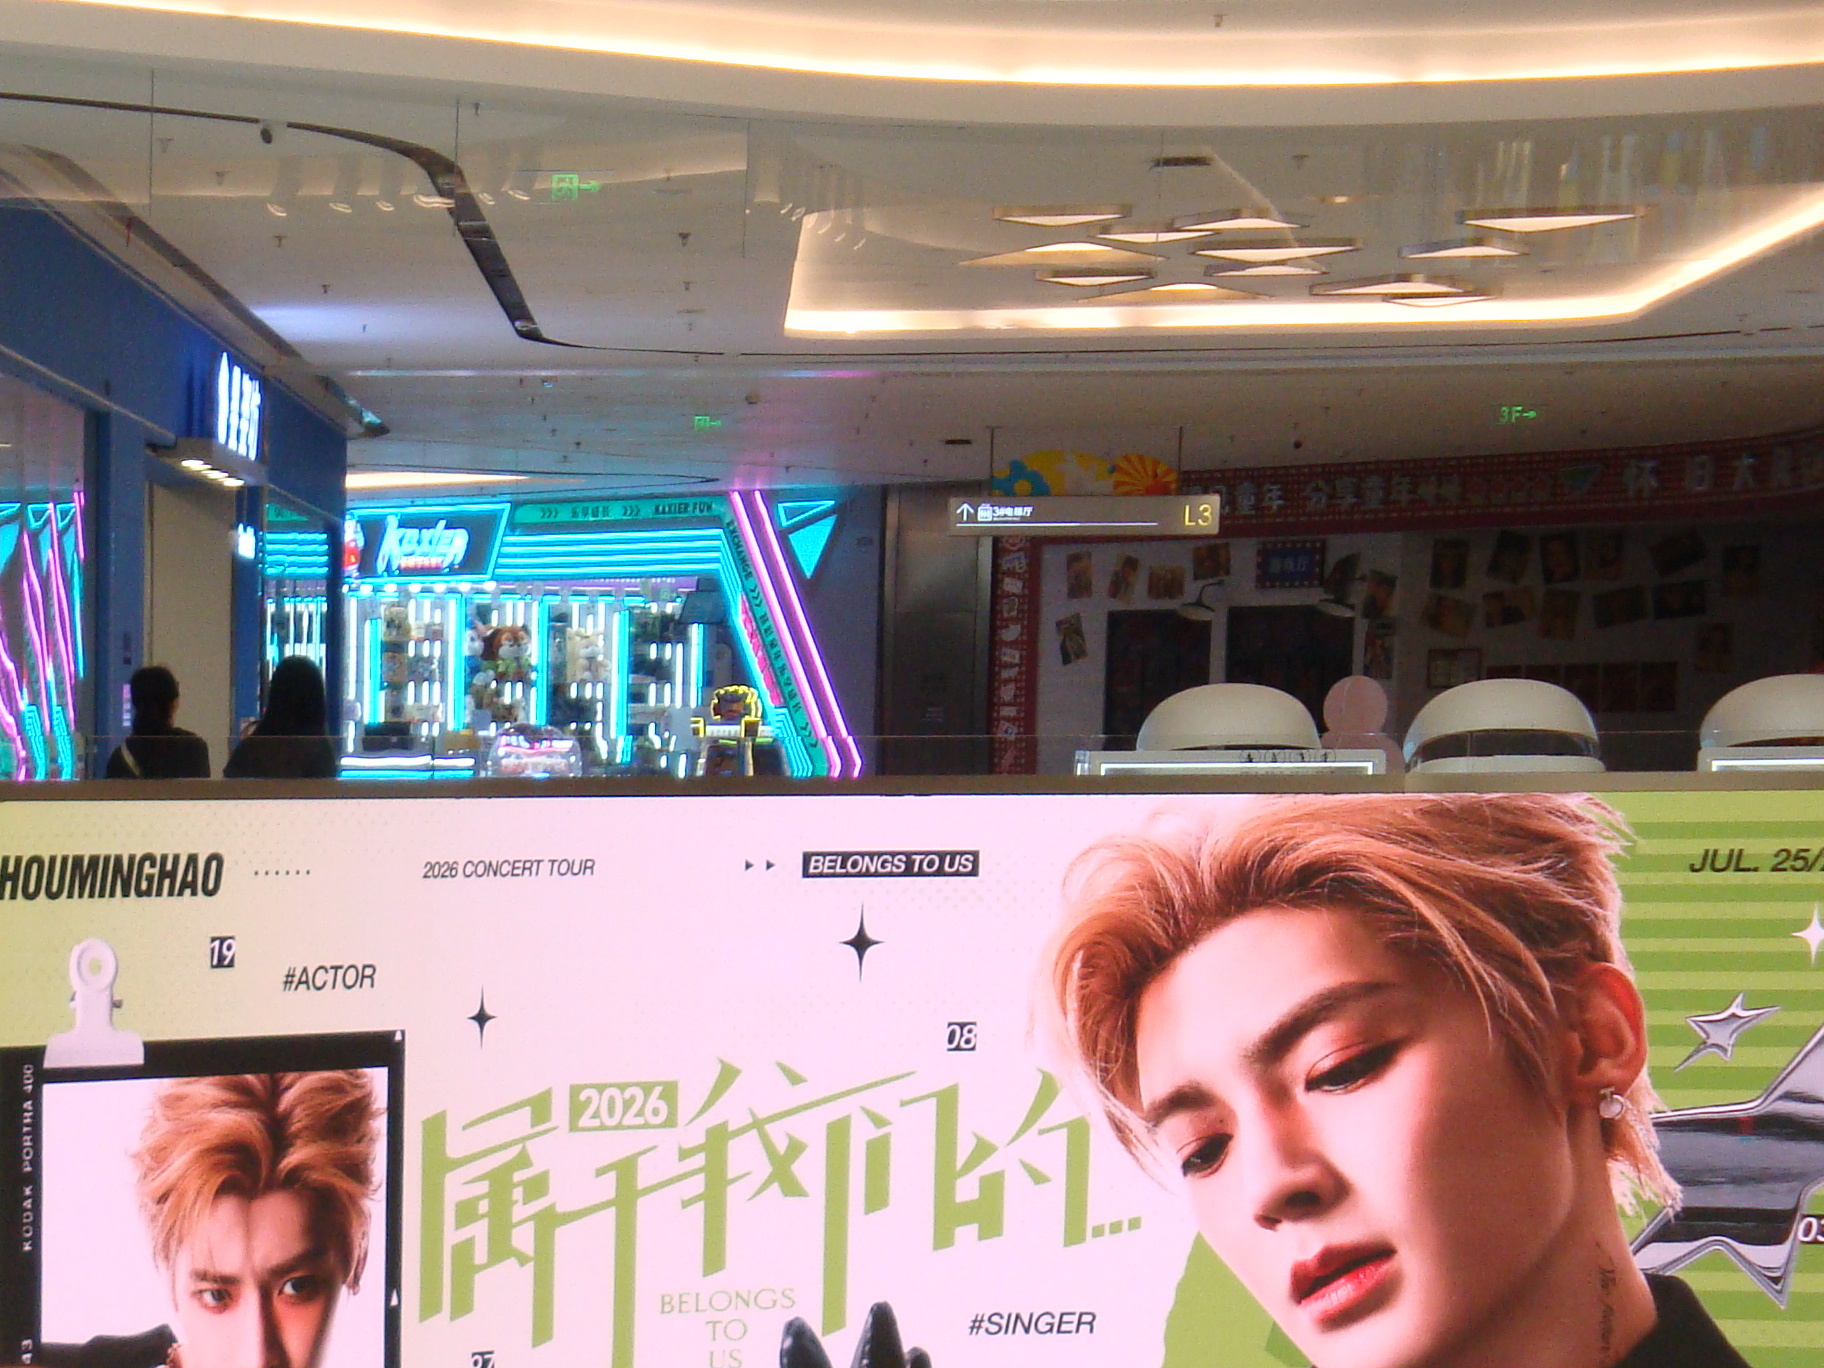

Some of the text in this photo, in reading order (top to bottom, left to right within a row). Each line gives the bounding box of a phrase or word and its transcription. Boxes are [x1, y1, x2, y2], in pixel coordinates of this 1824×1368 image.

[1184, 504, 1213, 527] L3
[423, 859, 596, 879] 2026 CONCERT TOUR
[808, 853, 974, 875] BELONGS TO US
[1689, 848, 1824, 872] JUL. 25/
[210, 938, 236, 966] 19
[282, 964, 376, 993] #ACTOR
[947, 1024, 977, 1051] 08
[578, 1086, 669, 1127] 2026
[22, 1184, 34, 1252] KODAK
[660, 1288, 796, 1315] BELONGS
[705, 1318, 749, 1343] TO
[968, 1311, 1097, 1337] #SINGER
